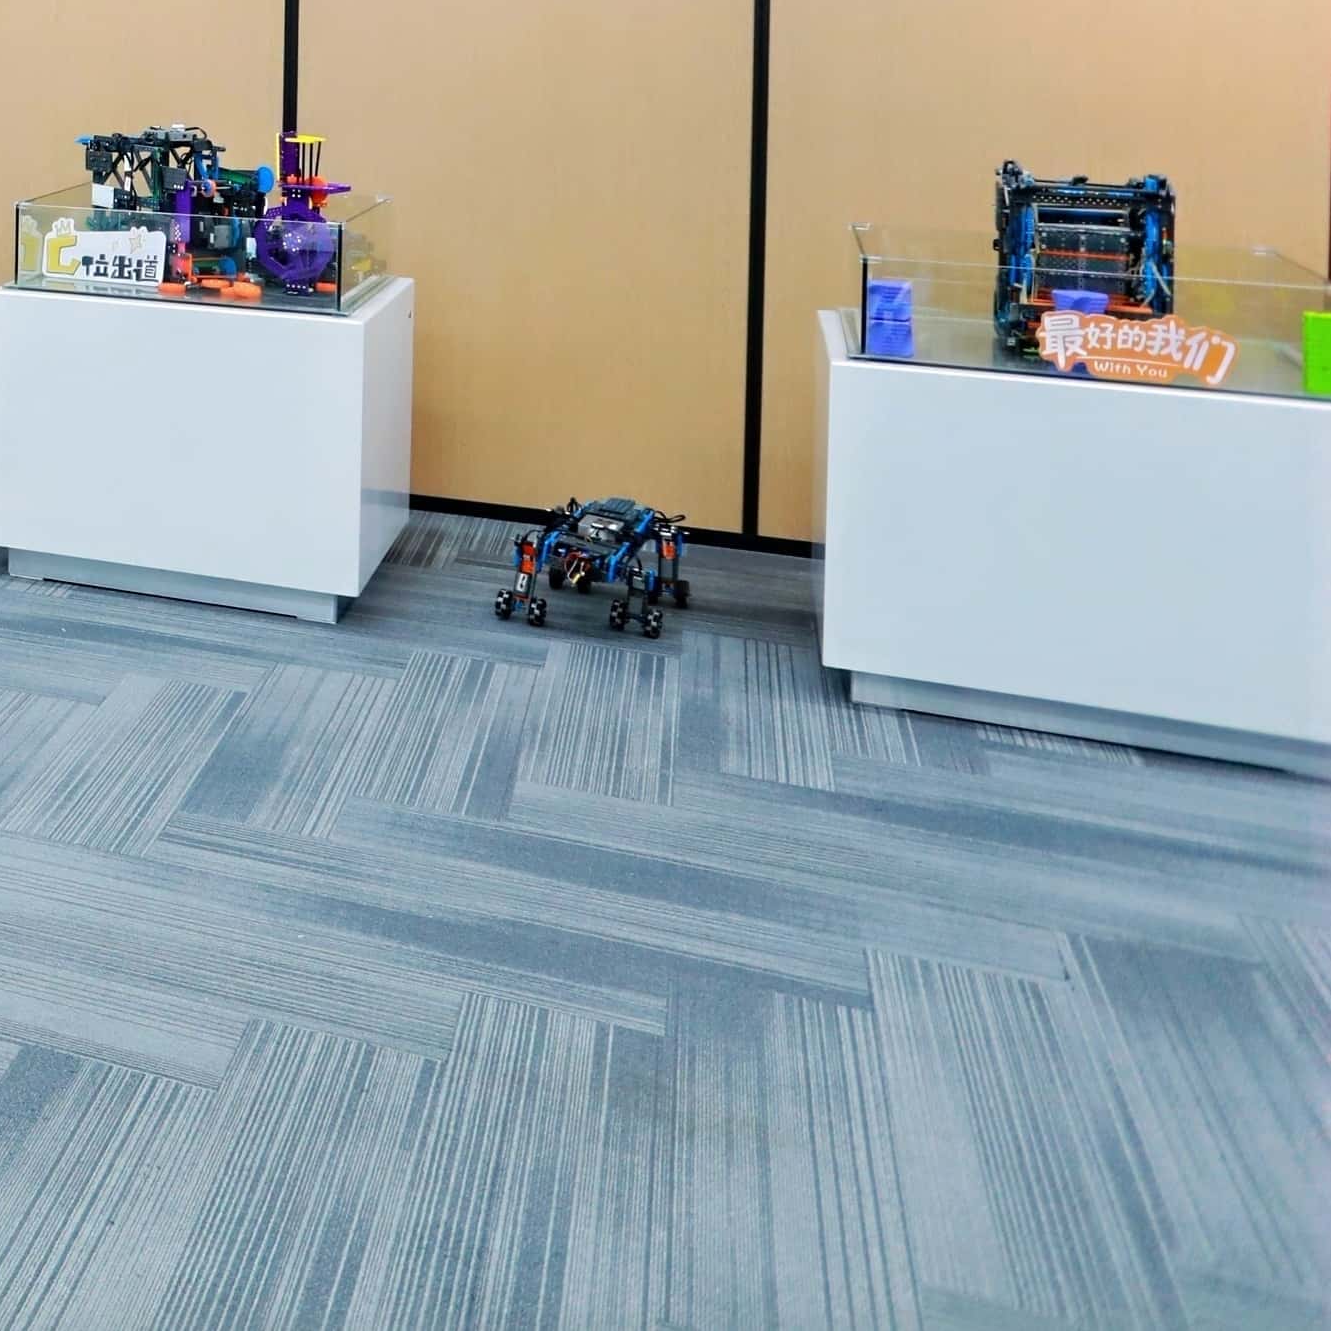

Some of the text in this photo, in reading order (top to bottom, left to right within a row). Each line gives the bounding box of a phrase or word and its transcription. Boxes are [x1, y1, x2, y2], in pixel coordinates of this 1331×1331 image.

[1039, 314, 1236, 384] 最好的我们
[1094, 360, 1168, 378] With You
